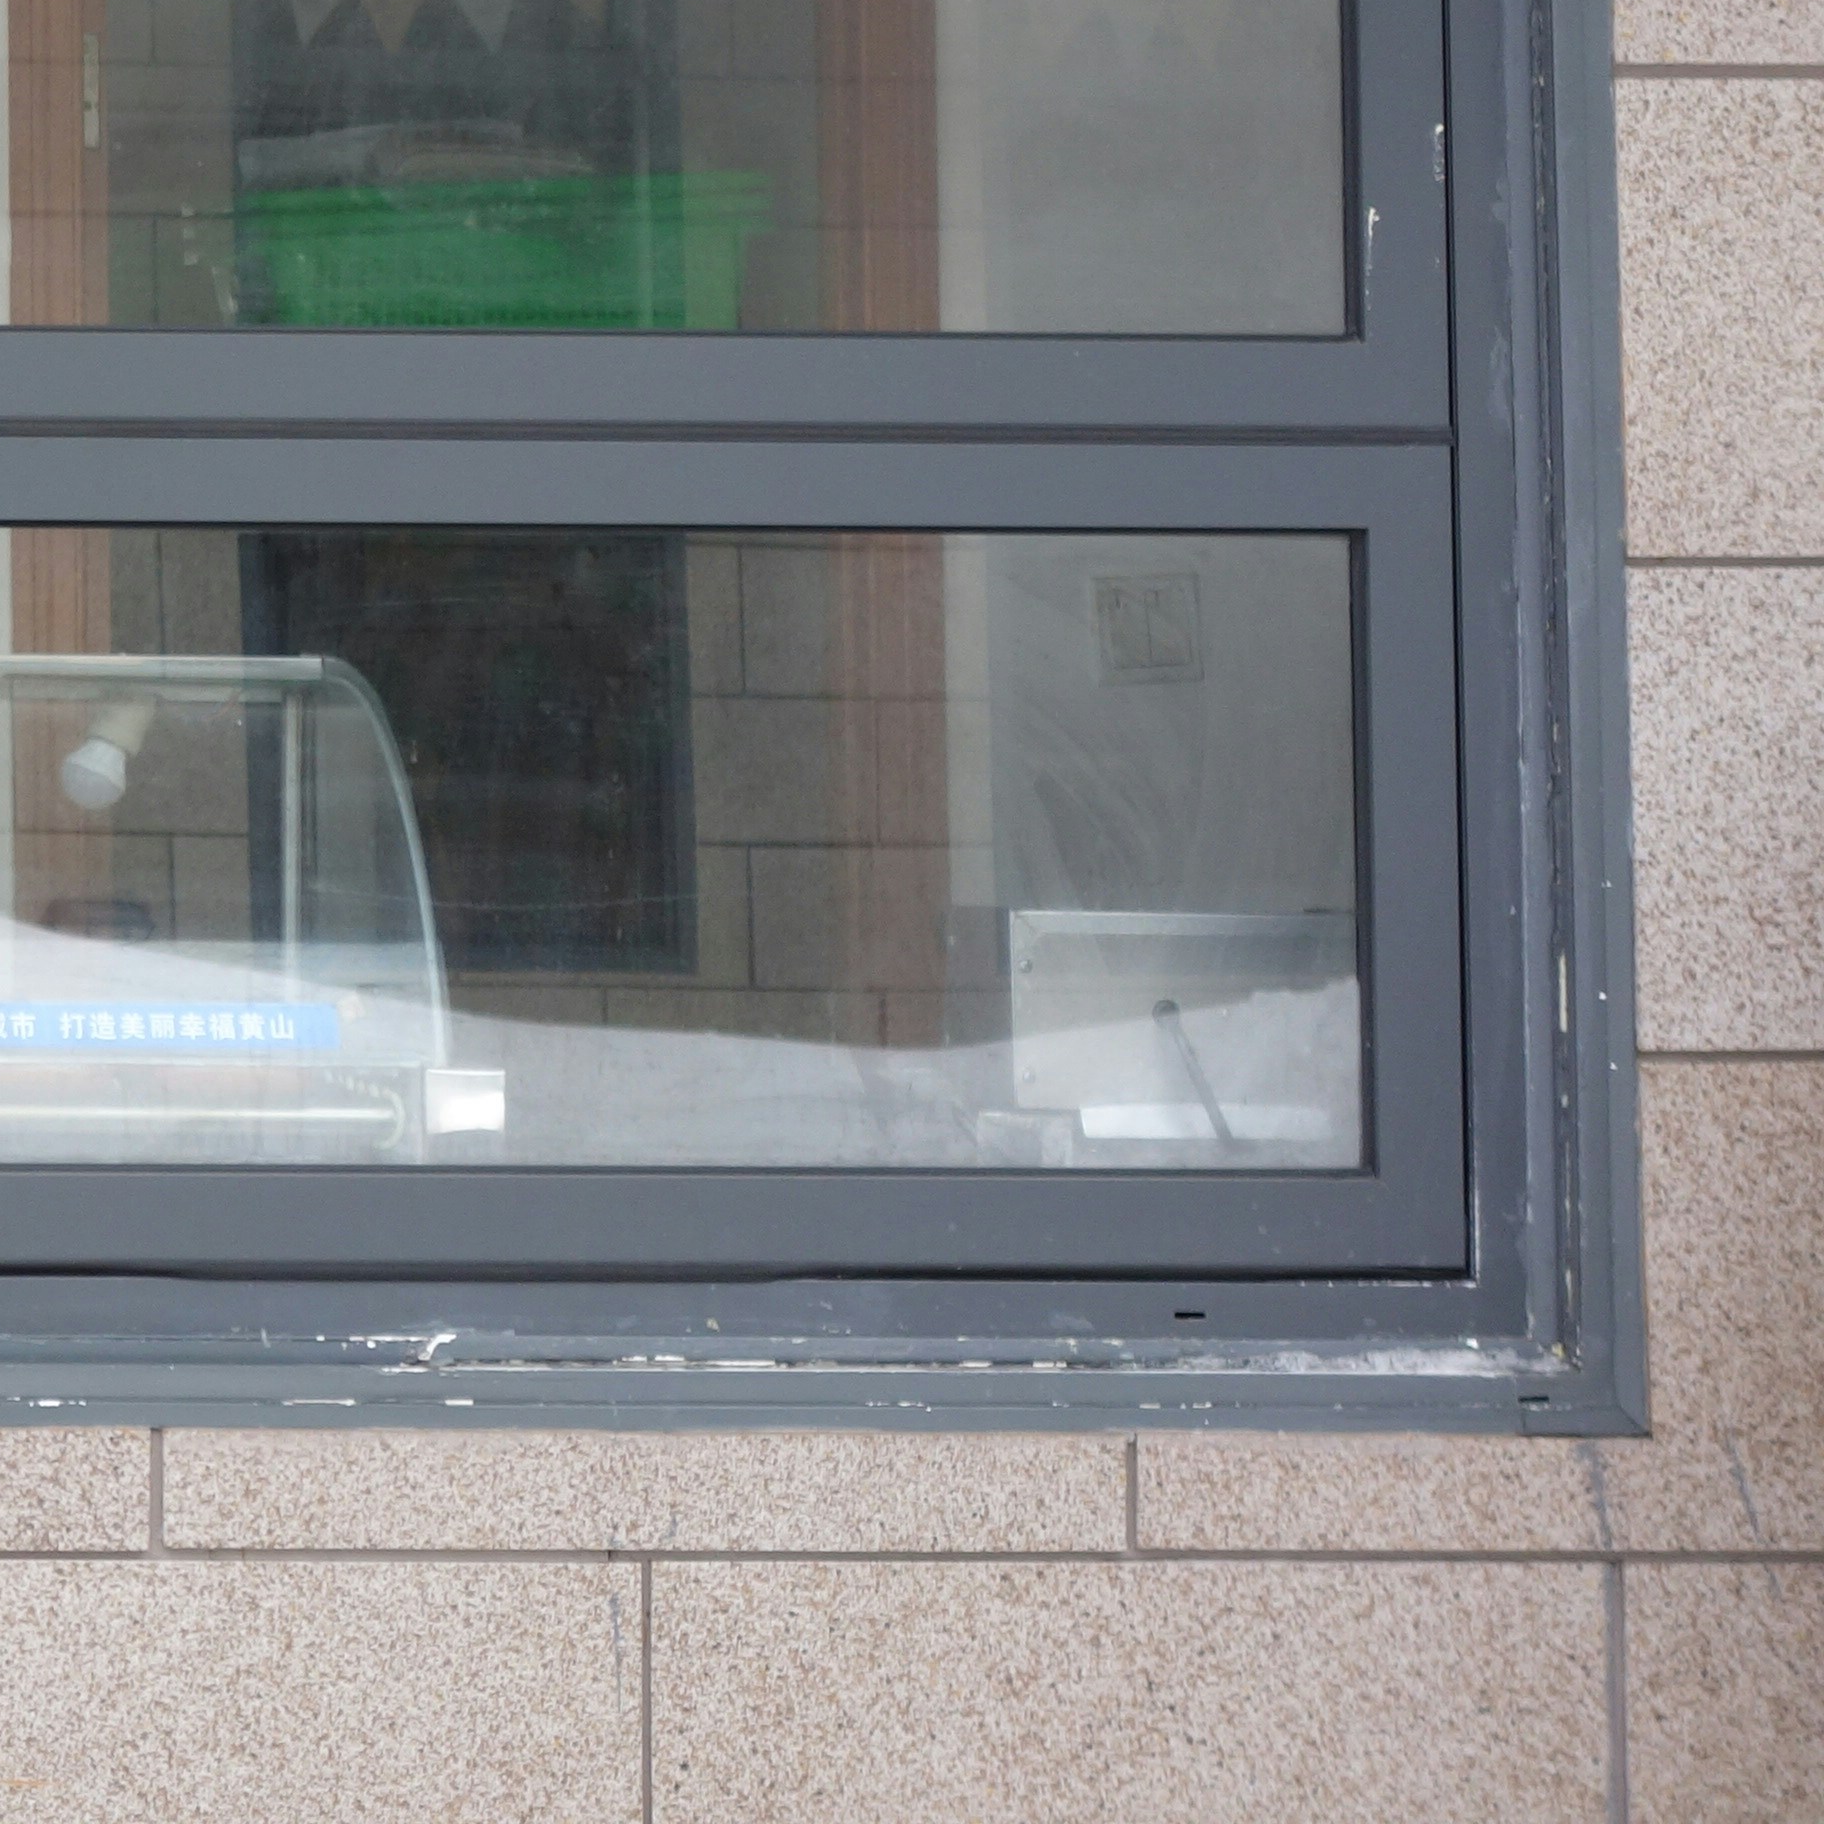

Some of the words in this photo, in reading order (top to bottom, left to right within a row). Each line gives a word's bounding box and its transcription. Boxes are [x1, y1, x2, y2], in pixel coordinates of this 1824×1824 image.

[59, 1010, 295, 1042] 打造美丽幸福黄山
